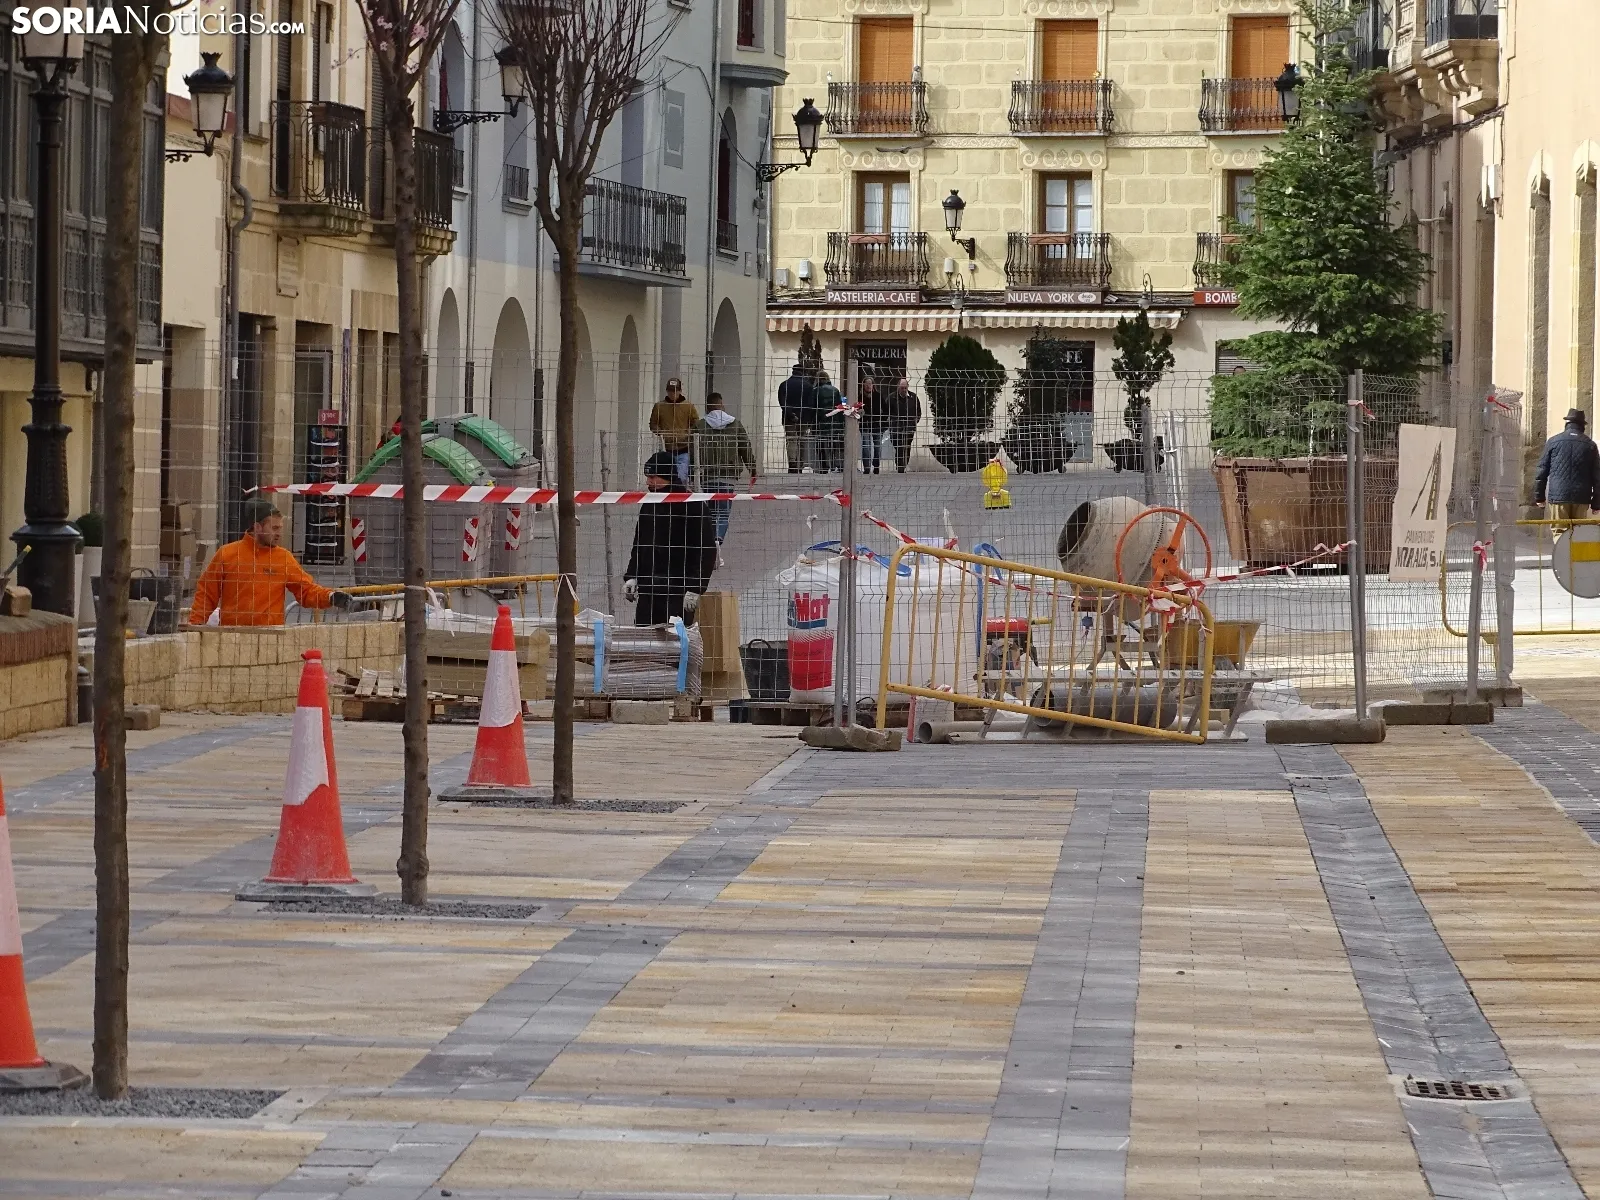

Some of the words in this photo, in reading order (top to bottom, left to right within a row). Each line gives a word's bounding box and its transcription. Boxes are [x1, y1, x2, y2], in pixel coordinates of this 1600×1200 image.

[827, 291, 917, 303] PASTELERIA-CAFE
[1007, 292, 1043, 303] NUEVA
[1047, 292, 1075, 303] YORK
[1205, 292, 1243, 303] BOMB
[848, 347, 907, 359] PASTELERIA
